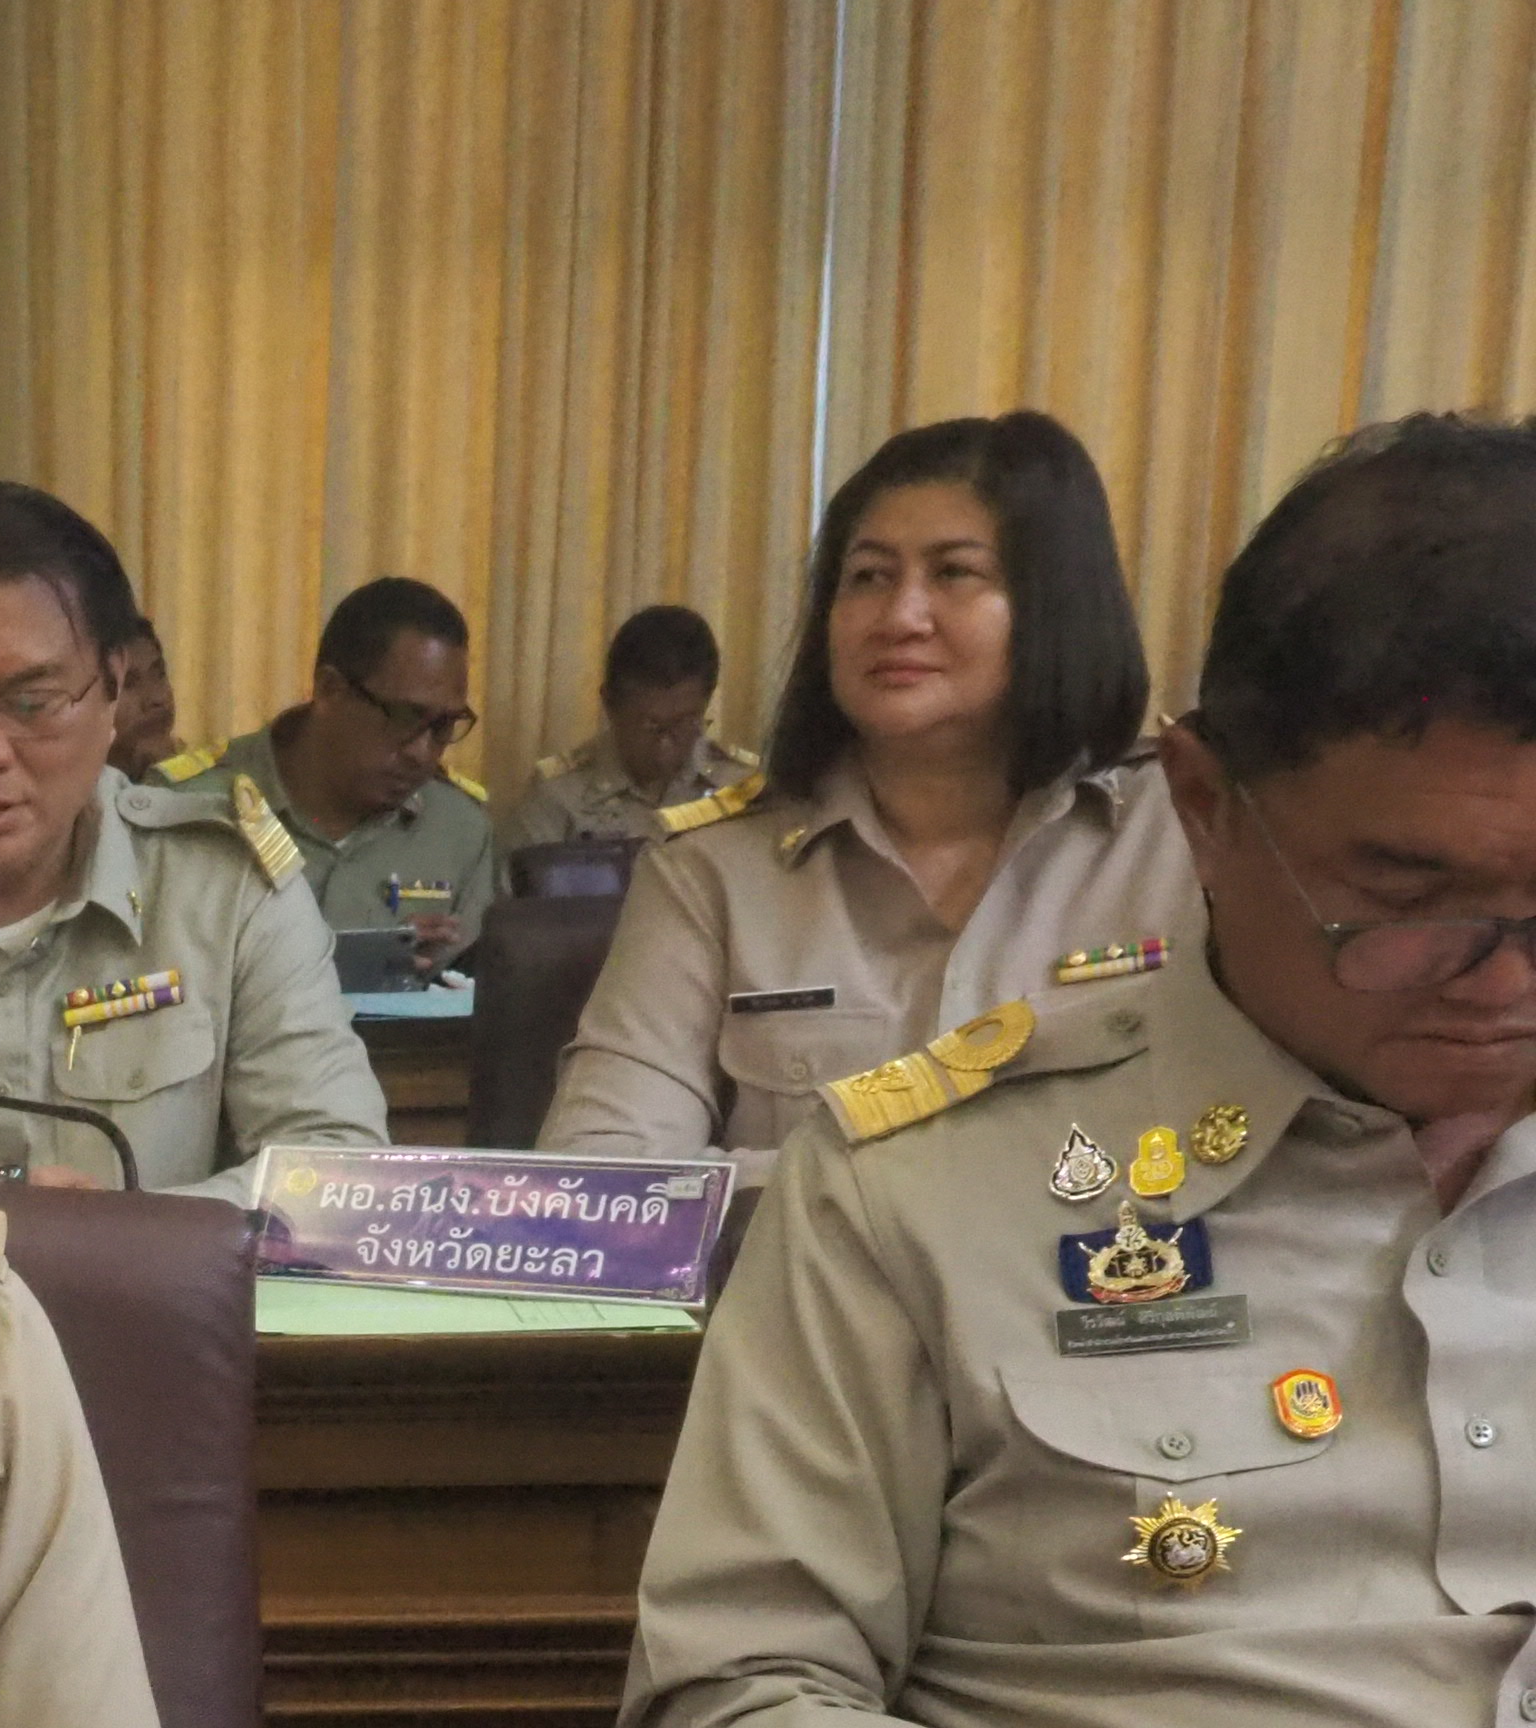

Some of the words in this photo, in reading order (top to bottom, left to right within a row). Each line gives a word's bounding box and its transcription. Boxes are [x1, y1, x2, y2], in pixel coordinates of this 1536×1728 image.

[356, 1223, 605, 1278] จังหวัดยะลา
